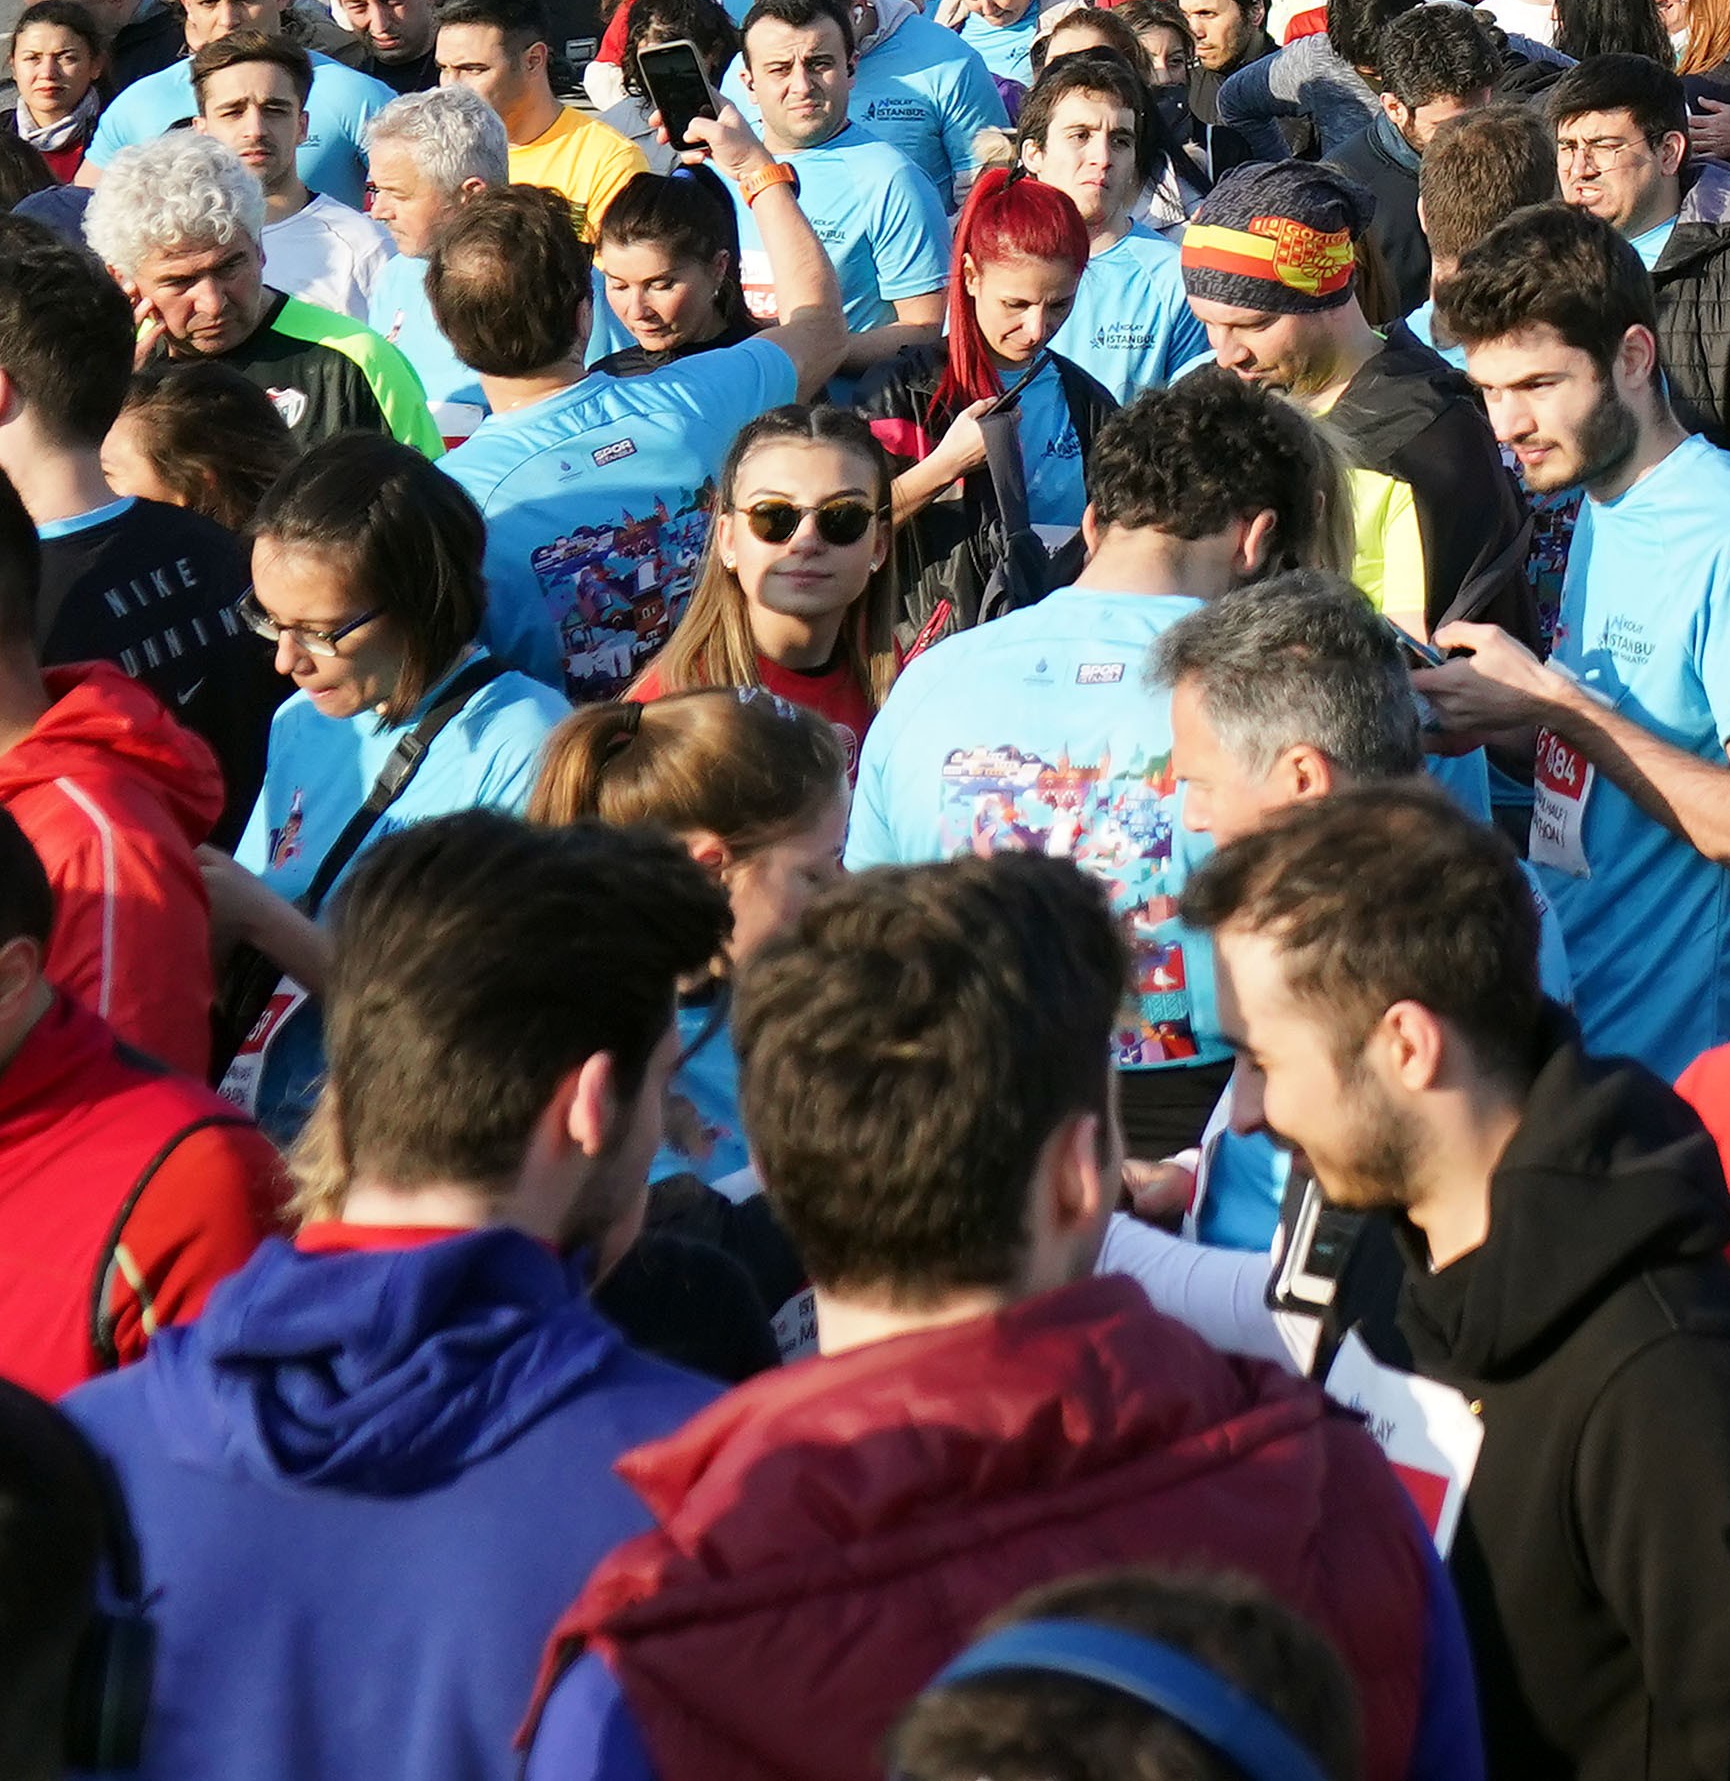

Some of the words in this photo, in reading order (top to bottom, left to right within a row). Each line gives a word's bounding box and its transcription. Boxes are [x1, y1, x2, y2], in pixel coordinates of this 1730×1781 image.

[594, 439, 632, 461] SPOR
[104, 557, 197, 618] NIKE
[119, 607, 240, 679] UNNIN
[1080, 664, 1122, 676] SPOR
